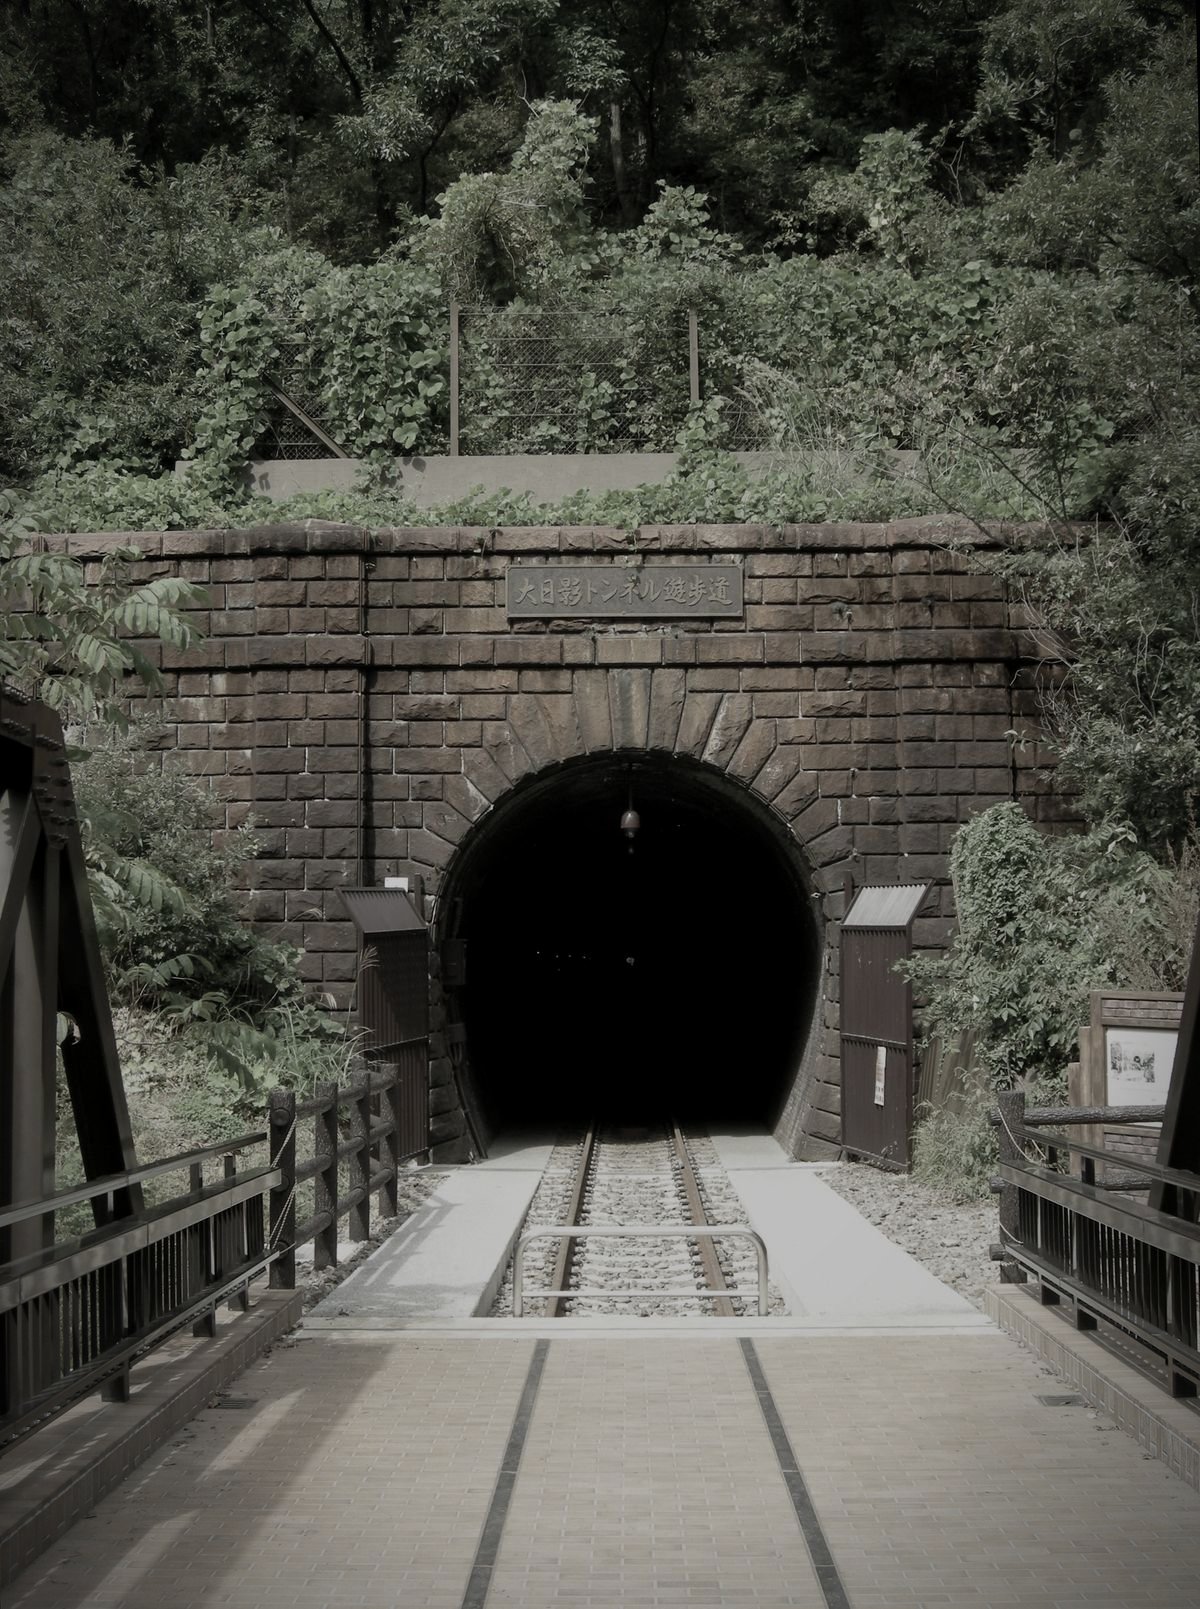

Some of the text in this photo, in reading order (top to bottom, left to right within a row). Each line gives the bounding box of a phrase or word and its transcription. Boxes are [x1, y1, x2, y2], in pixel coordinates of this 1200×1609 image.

[515, 574, 733, 606] 大日影トンネル遊歩道
